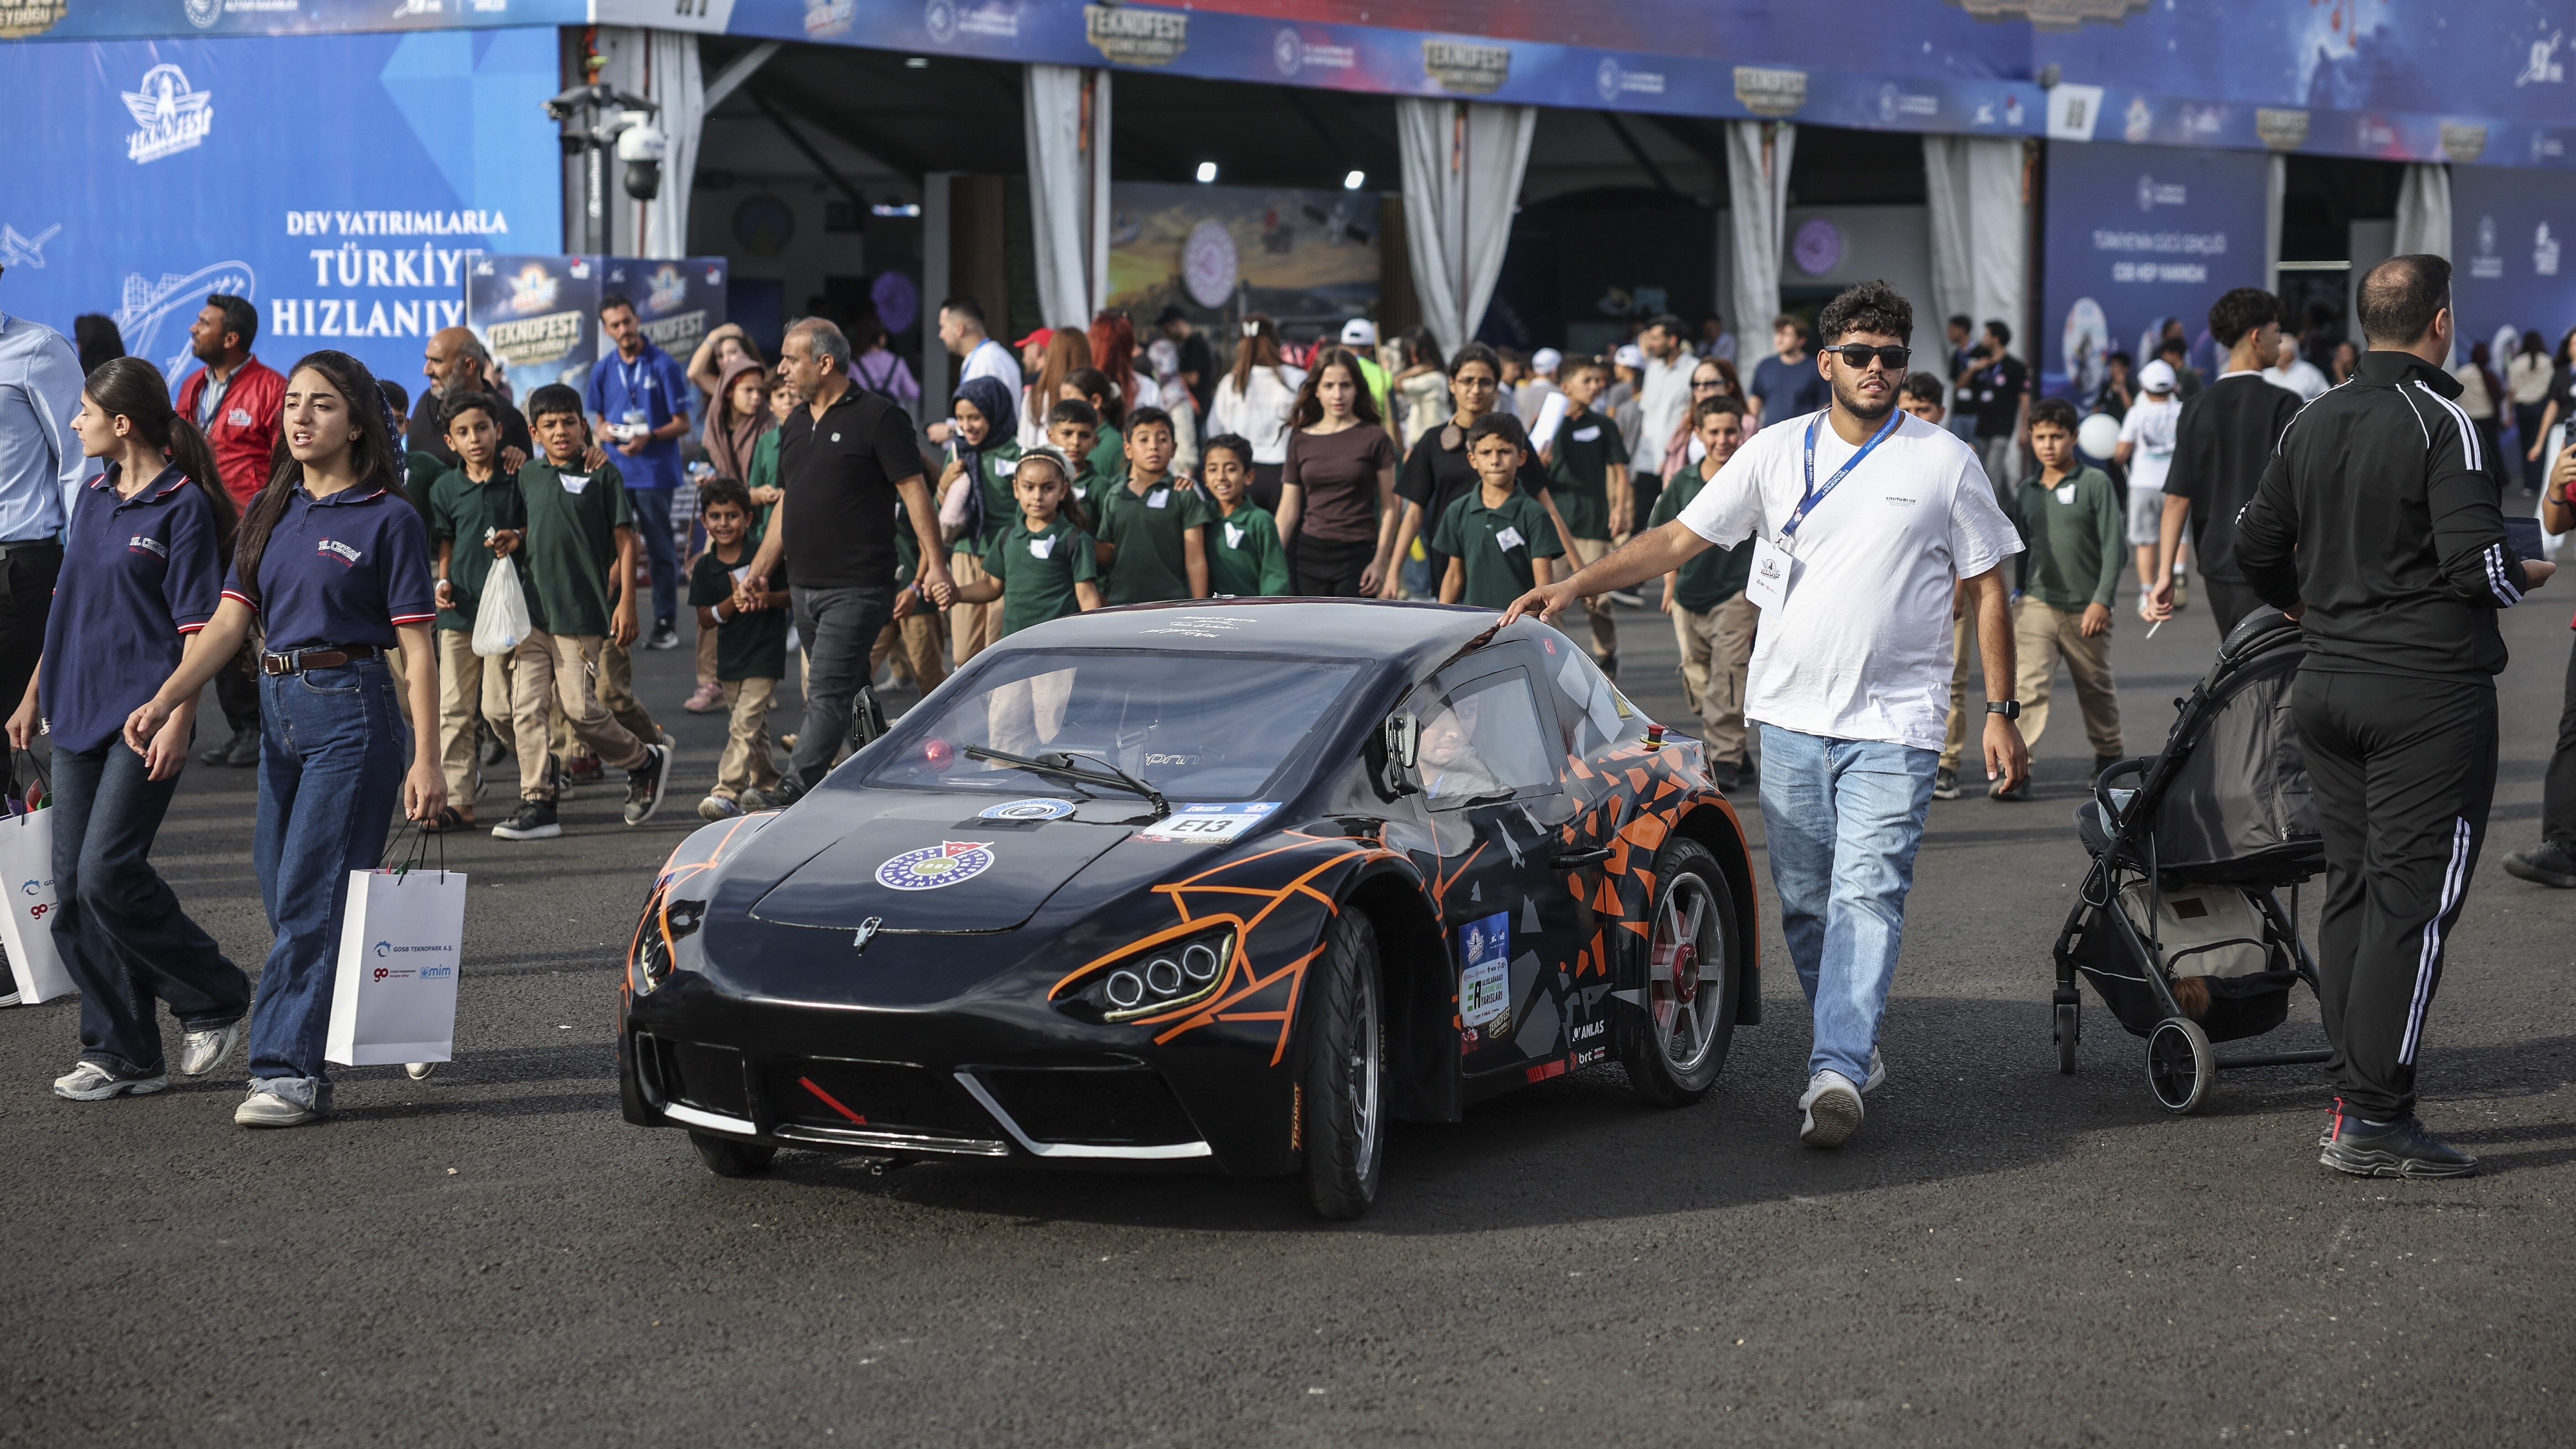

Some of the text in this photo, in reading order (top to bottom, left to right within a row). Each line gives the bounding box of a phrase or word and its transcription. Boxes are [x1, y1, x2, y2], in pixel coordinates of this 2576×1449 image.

[287, 210, 508, 236] DEV YATIRIMLARLA
[310, 241, 483, 286] TÜRKİY
[487, 311, 582, 347] TEKNOFEST
[1821, 469, 1849, 496] TEKNOFEST
[1886, 497, 1916, 505] SOUTHBLUE
[1170, 820, 1233, 832] E13
[2090, 874, 2100, 893] prego
[430, 964, 451, 976] mim
[1482, 974, 1503, 986] ULUSLARARASI
[1481, 991, 1503, 1006] YARIŞLARI
[1489, 1007, 1510, 1033] TEKNOFEST
[1581, 1020, 1604, 1039] ANLAS
[1579, 1050, 1592, 1064] brt
